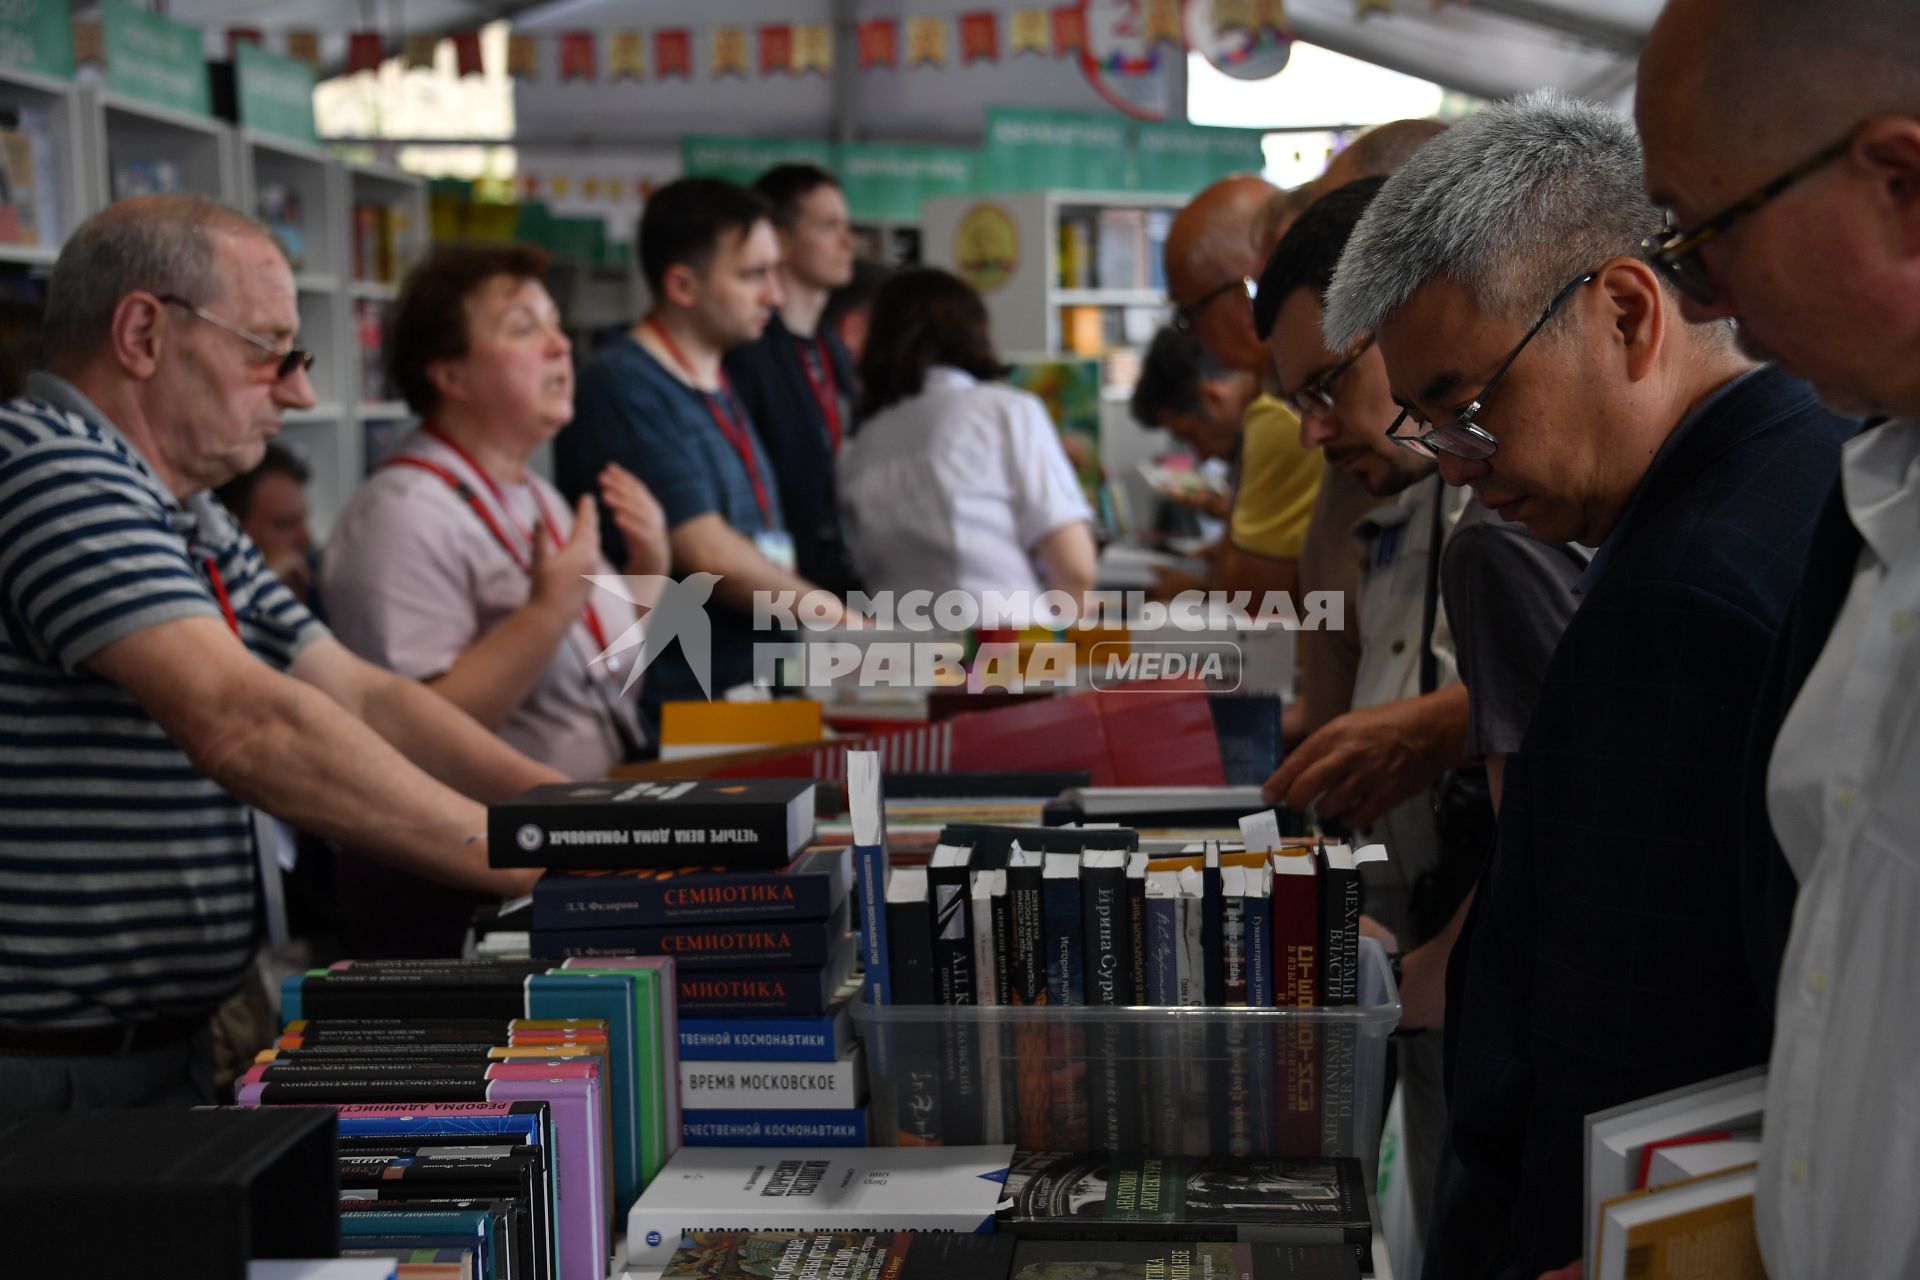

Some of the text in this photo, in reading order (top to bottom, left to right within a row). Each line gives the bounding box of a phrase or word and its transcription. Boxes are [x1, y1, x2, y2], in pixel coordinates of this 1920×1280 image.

[549, 828, 758, 845] ЧЕТЫРЕ ВЕКА ДОМА РОМАНОВЫХ
[664, 884, 796, 906] СЕМИОТИКА
[1016, 890, 1025, 925] ИСТОРИИ
[1024, 890, 1032, 920] РОССИИ
[1018, 926, 1025, 937] ПО
[1095, 888, 1115, 951] Ирина
[660, 931, 792, 953] СЕМИОТИКА
[1025, 928, 1034, 951] ДВОРА
[1251, 916, 1264, 981] Гуманитарный
[1342, 880, 1360, 999] МЕХАНИЗМЫ
[1058, 936, 1071, 977] История
[1328, 928, 1343, 999] ВЛАСТИ
[678, 981, 786, 999] МИОТИКА
[1026, 953, 1036, 997] ГОСУДАРЕВА
[681, 1032, 825, 1047] ТВЕННОЙ КОСМОНАВТИКИ
[953, 952, 971, 1096] А.П. КТКОВСКИЙ
[690, 1074, 836, 1090] ВРЕМЯ МОСКОВСКОЕ
[336, 1102, 506, 1114] РЕФОРМА АДМИНИСТР
[1339, 1084, 1353, 1117] DER
[683, 1122, 856, 1138] ЕЧЕСТВЕННОЙ КОСМОНАВТИКИ
[1116, 1169, 1138, 1211] АНАТОМИЯ
[1139, 1159, 1163, 1212] АРХИТЕКТУРЫ
[772, 1239, 807, 1273] богатые
[797, 1234, 833, 1280] раны стали
[827, 1246, 860, 1280] гатыми,
[1145, 1257, 1165, 1280] ТИКА
[1171, 1249, 1191, 1280] МПАНЗЕ
